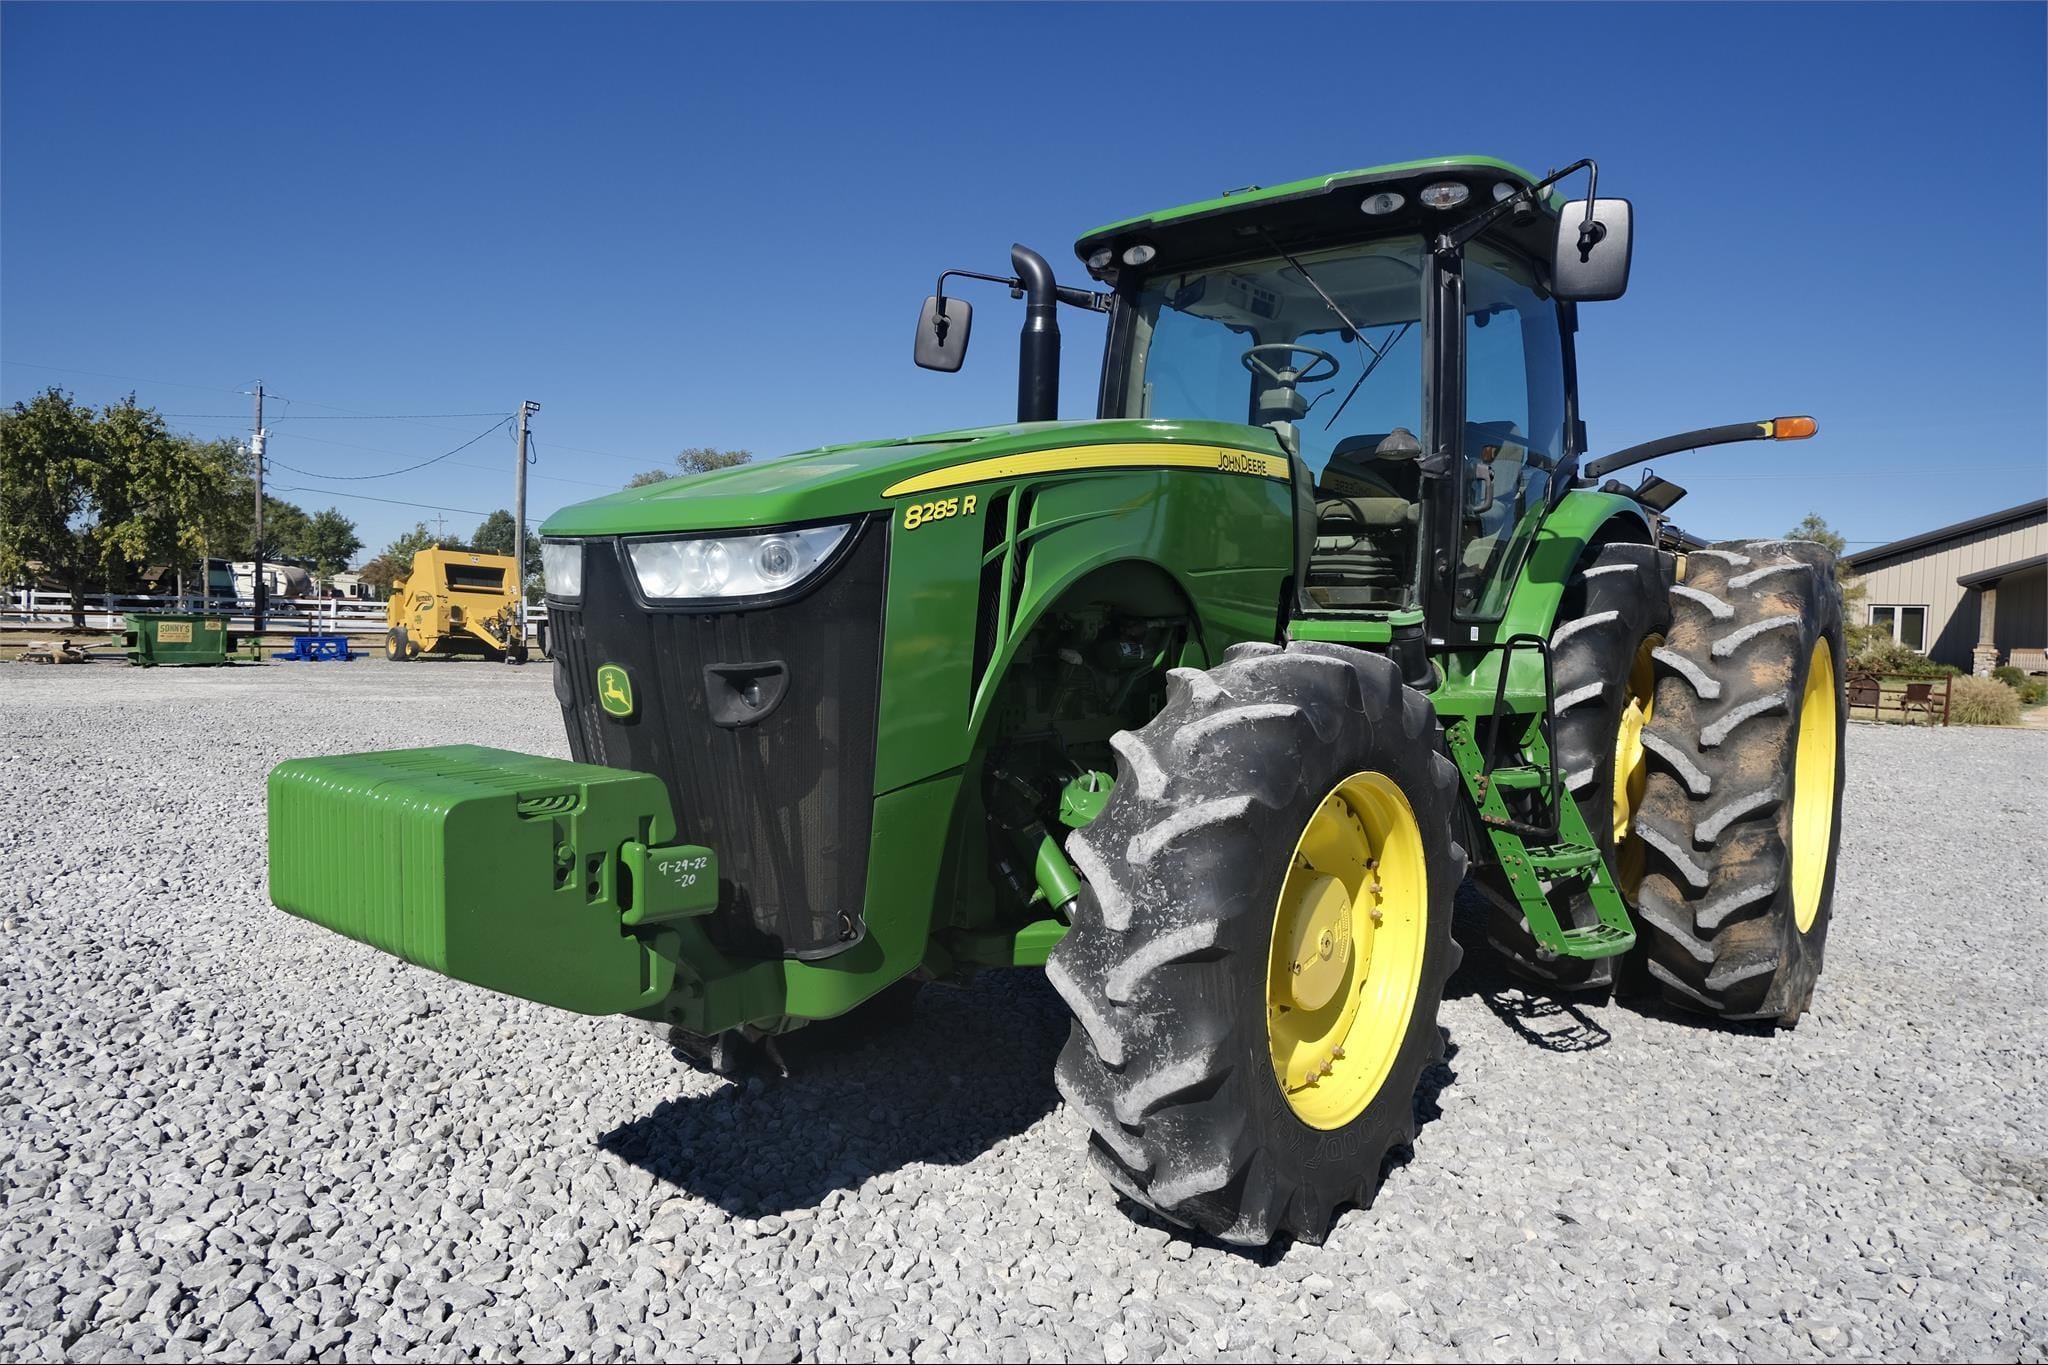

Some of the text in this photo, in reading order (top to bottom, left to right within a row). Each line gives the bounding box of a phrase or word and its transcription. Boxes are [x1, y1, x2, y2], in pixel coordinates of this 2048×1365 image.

[1218, 451, 1268, 476] JOHN DEERE
[904, 495, 977, 530] 8285 R
[658, 857, 707, 876] 9-29-22
[675, 874, 696, 887] -20
